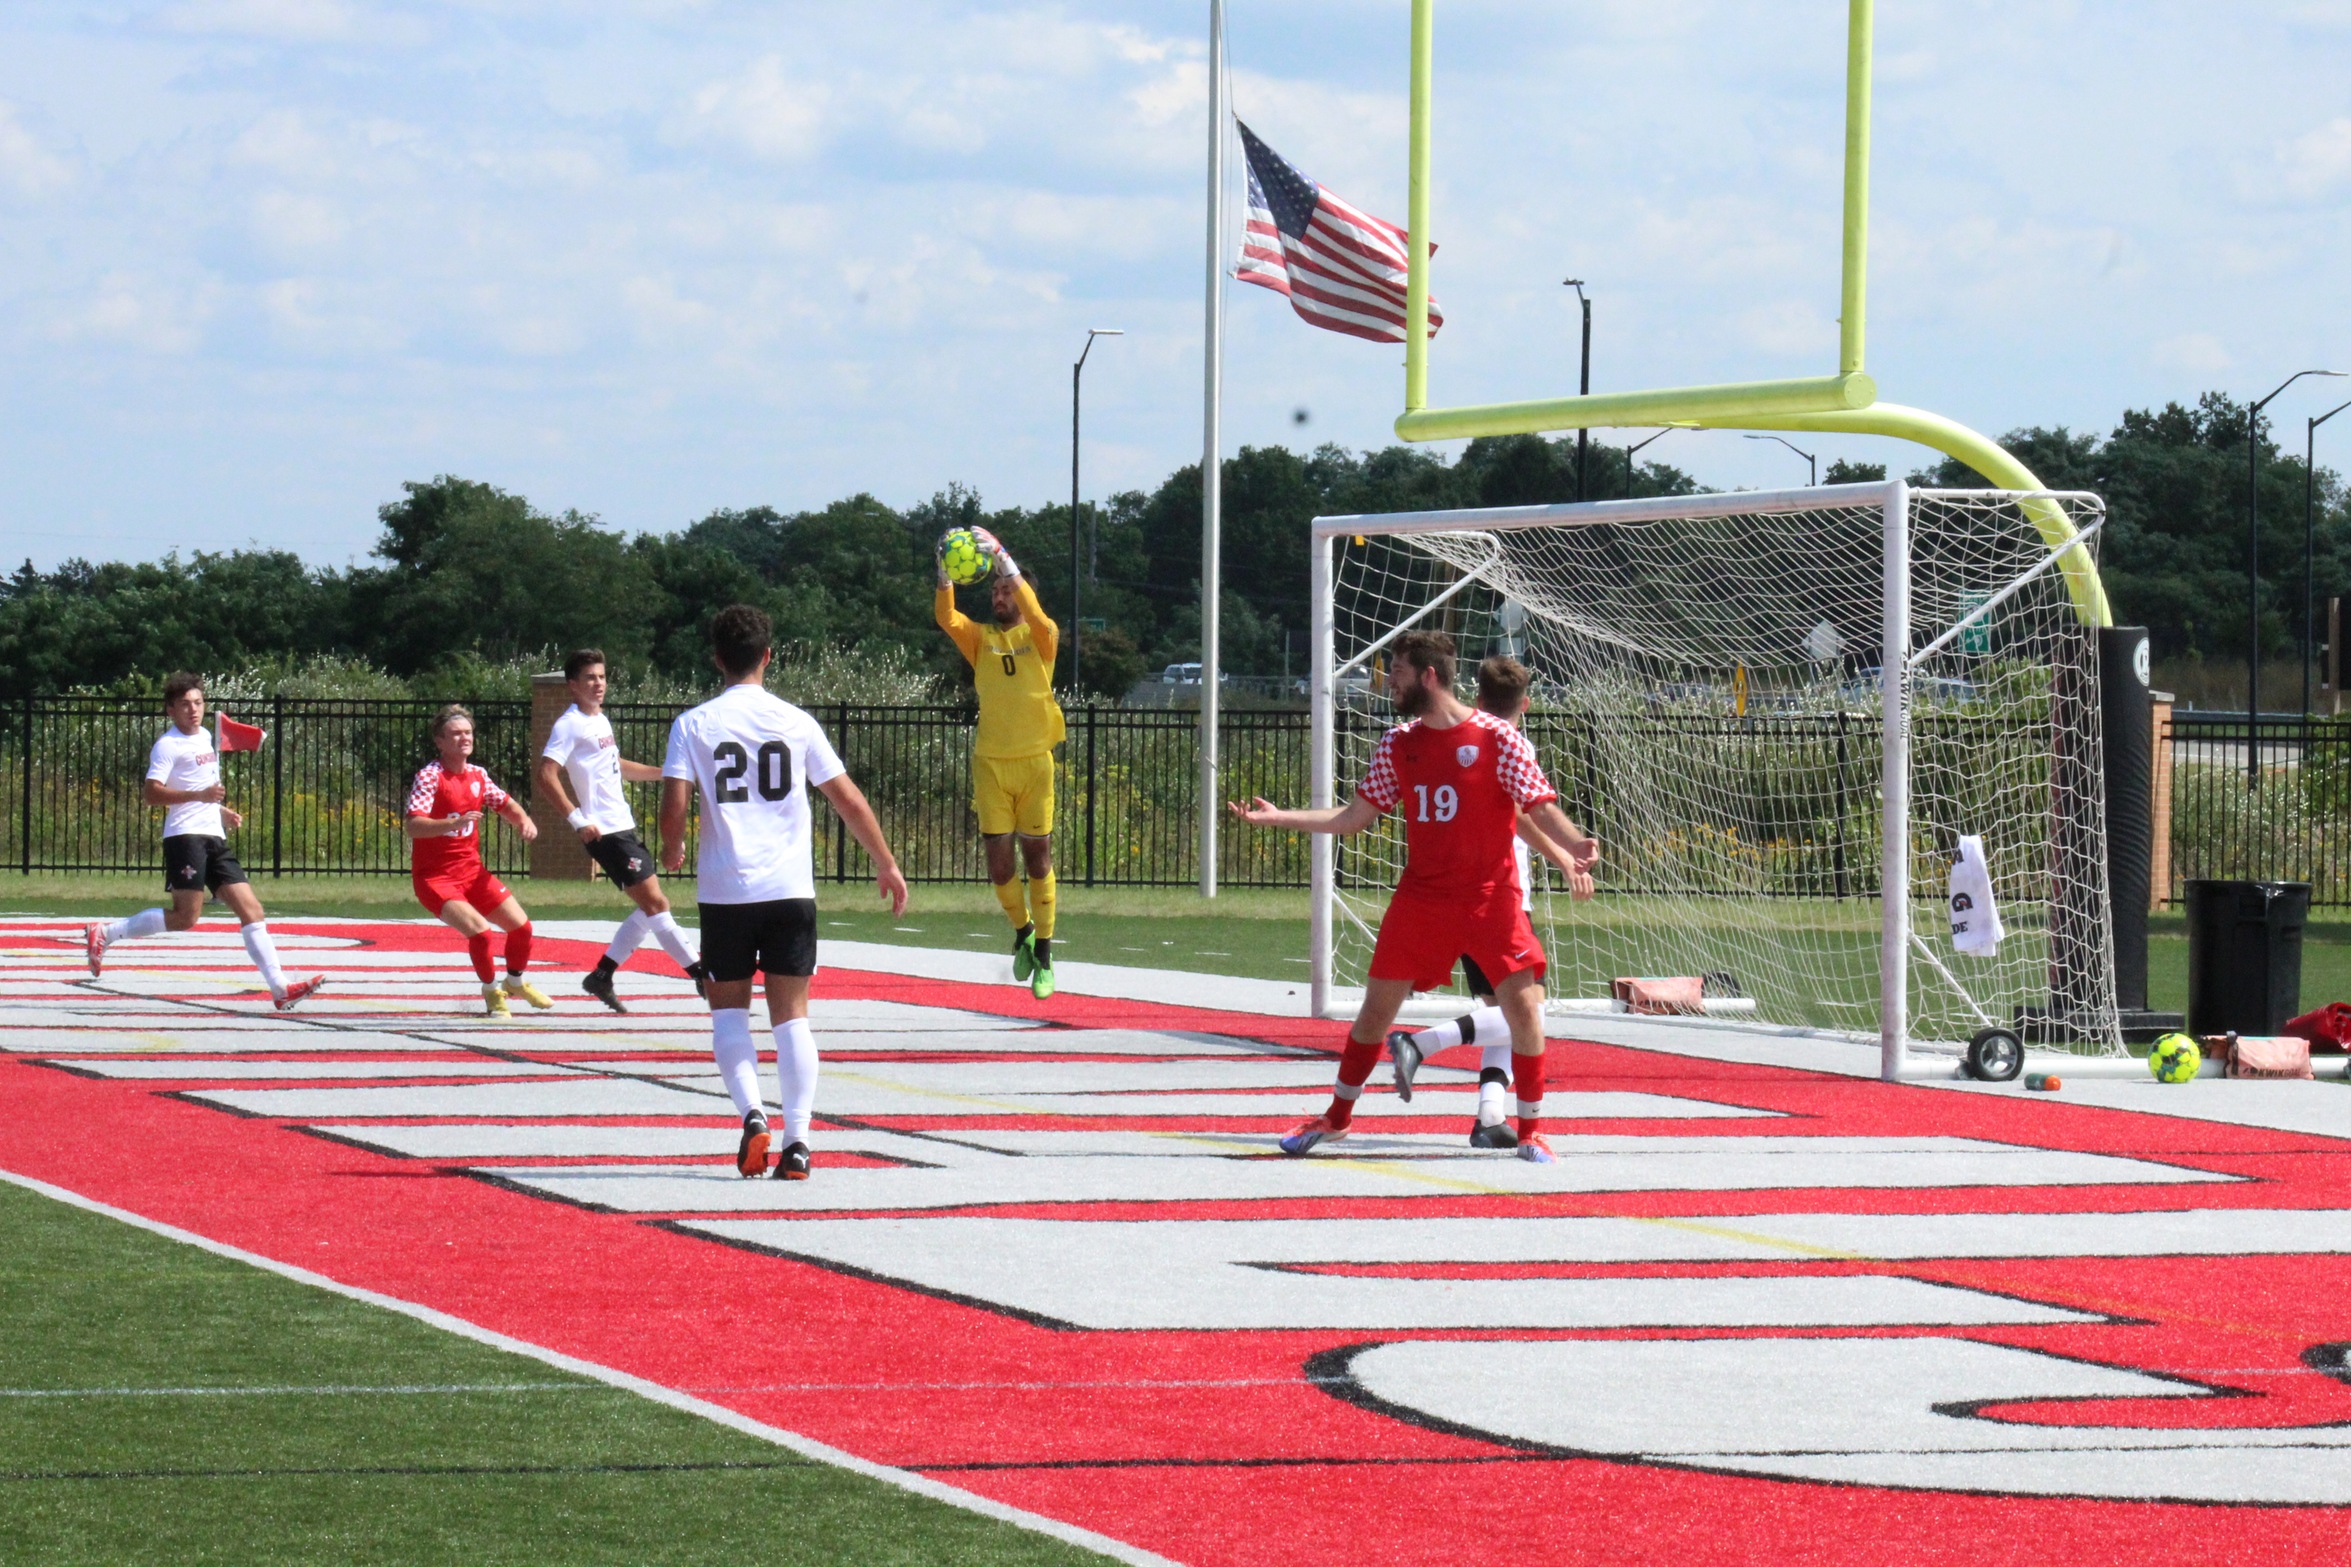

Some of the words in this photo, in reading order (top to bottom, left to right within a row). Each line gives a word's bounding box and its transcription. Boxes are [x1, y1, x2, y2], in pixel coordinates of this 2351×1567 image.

[1002, 655, 1016, 676] 0
[713, 741, 792, 803] 20
[1413, 784, 1459, 822] 19
